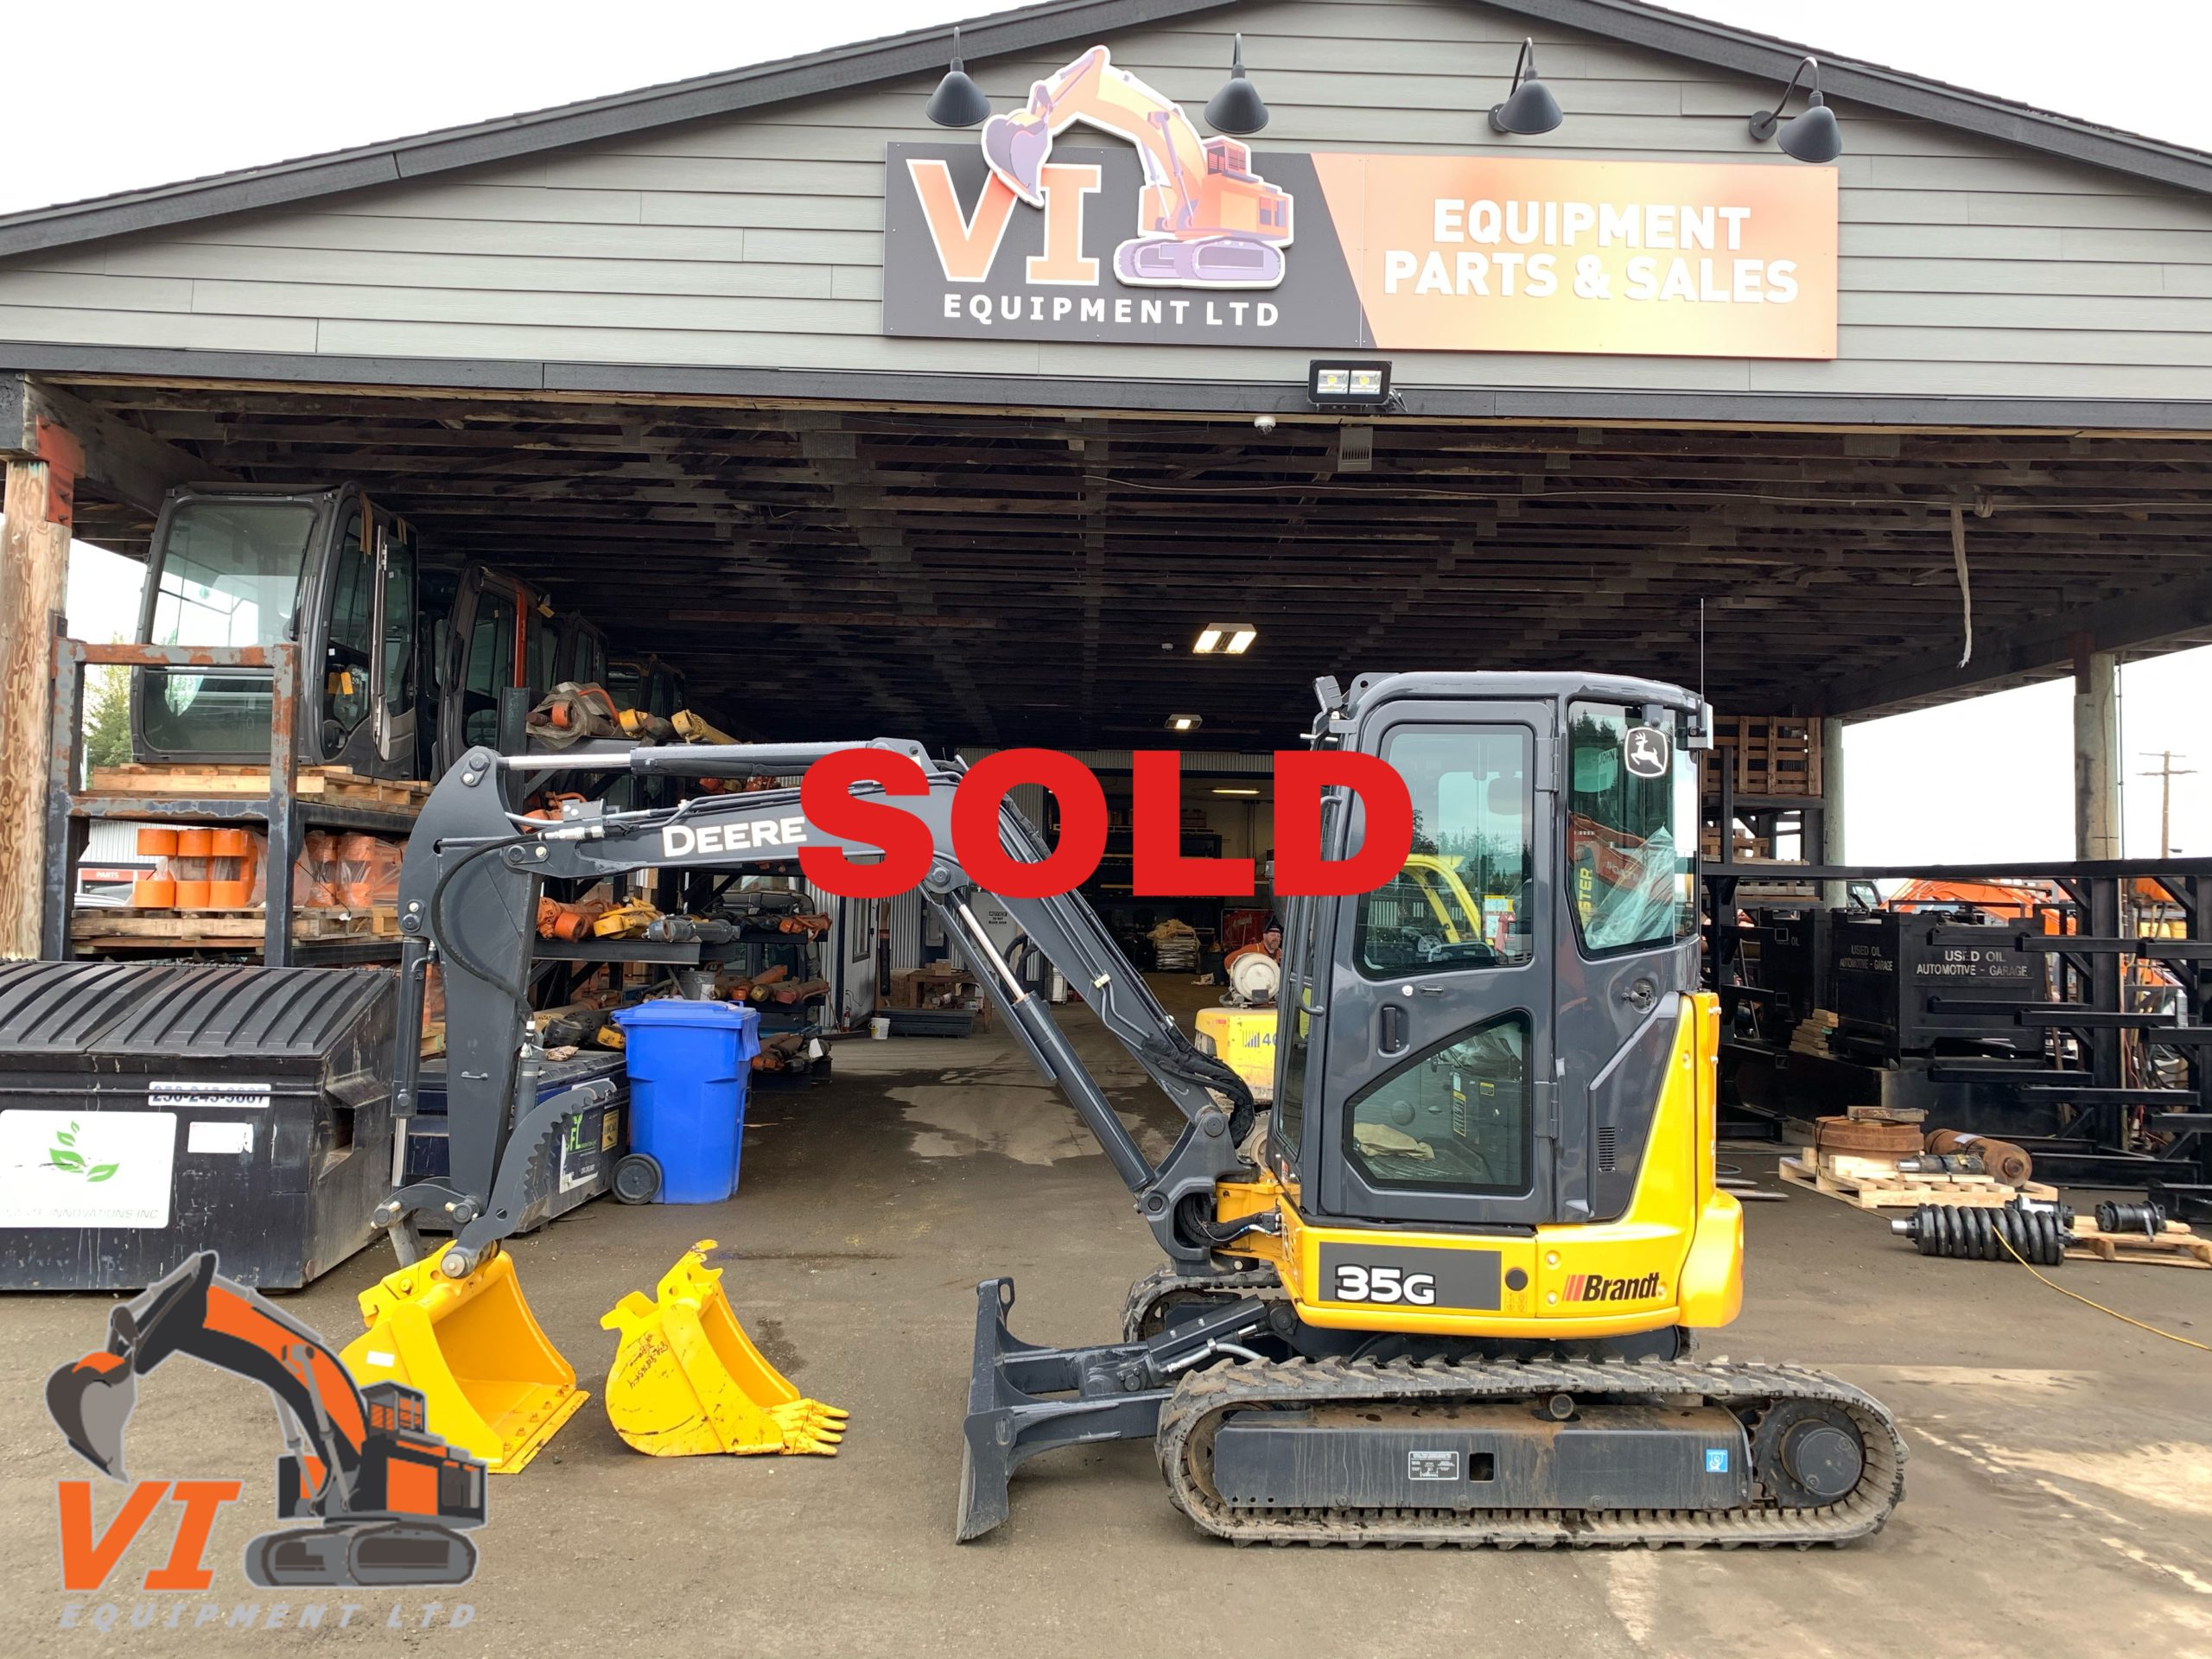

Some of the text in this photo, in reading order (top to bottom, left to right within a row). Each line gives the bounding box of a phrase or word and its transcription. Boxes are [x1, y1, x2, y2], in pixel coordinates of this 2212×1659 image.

[906, 159, 1102, 286] VI
[1434, 199, 1751, 251] EQUIPMENT
[1384, 251, 1798, 304] PARTS & SALES
[944, 294, 1279, 327] EQUIPMENT LTD
[662, 816, 807, 857] DEERE
[1851, 944, 1882, 957] USED OIL
[1986, 950, 2006, 963] OIL
[1916, 963, 1976, 976] AUTOMOTIVE
[1989, 964, 2028, 976] GARAGE
[137, 1209, 158, 1219] INC
[1335, 1263, 1436, 1306] 35G
[1581, 1272, 1660, 1301] Brandt
